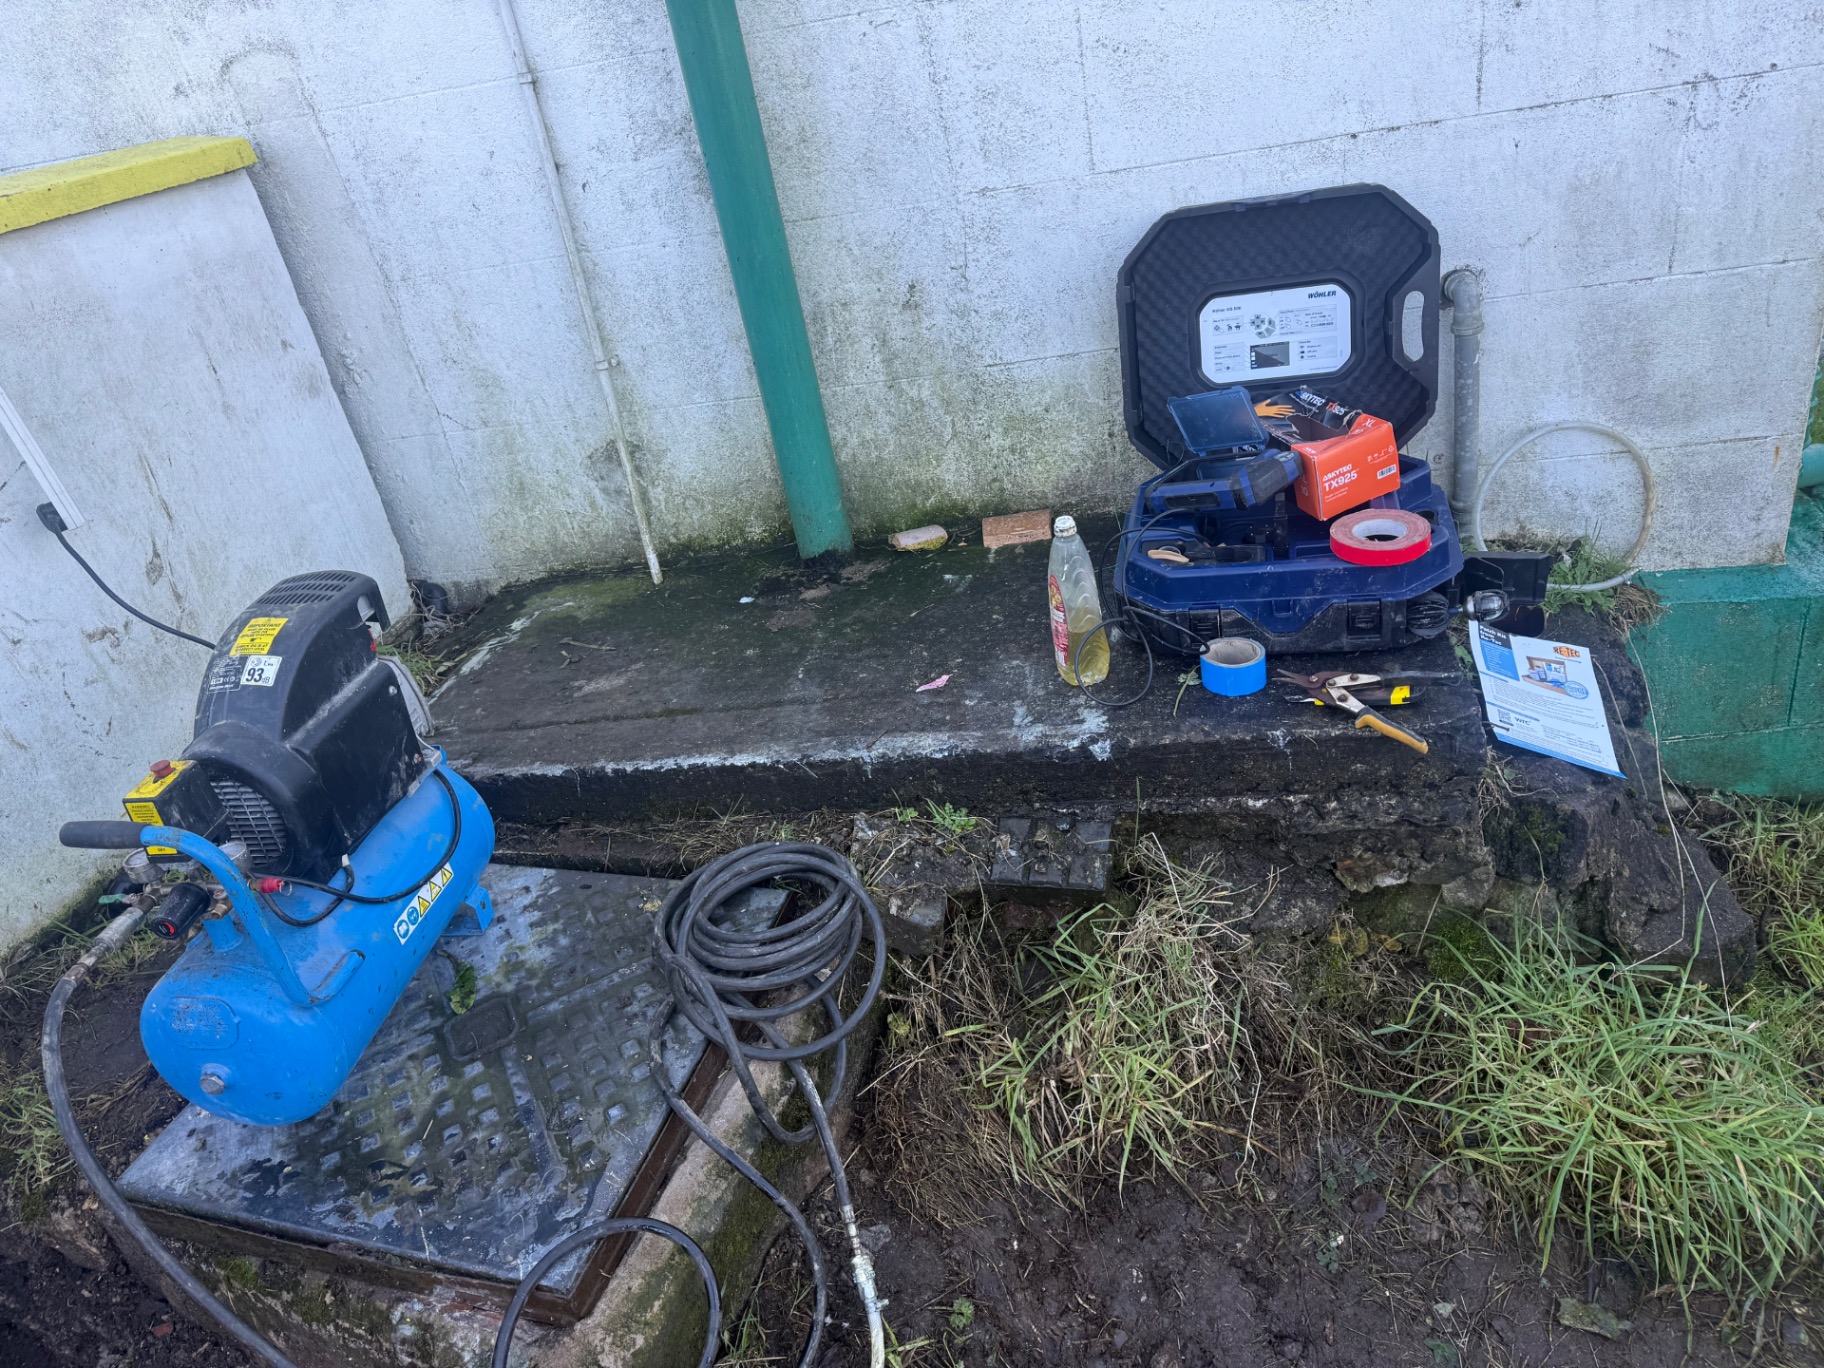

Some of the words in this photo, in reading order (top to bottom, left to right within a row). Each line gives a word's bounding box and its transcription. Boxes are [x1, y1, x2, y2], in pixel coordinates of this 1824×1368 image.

[1307, 290, 1337, 299] WÖHLER
[1362, 418, 1376, 428] XL
[1323, 470, 1358, 492] TX925
[1553, 646, 1581, 658] RE-TEC
[245, 667, 265, 683] 93
